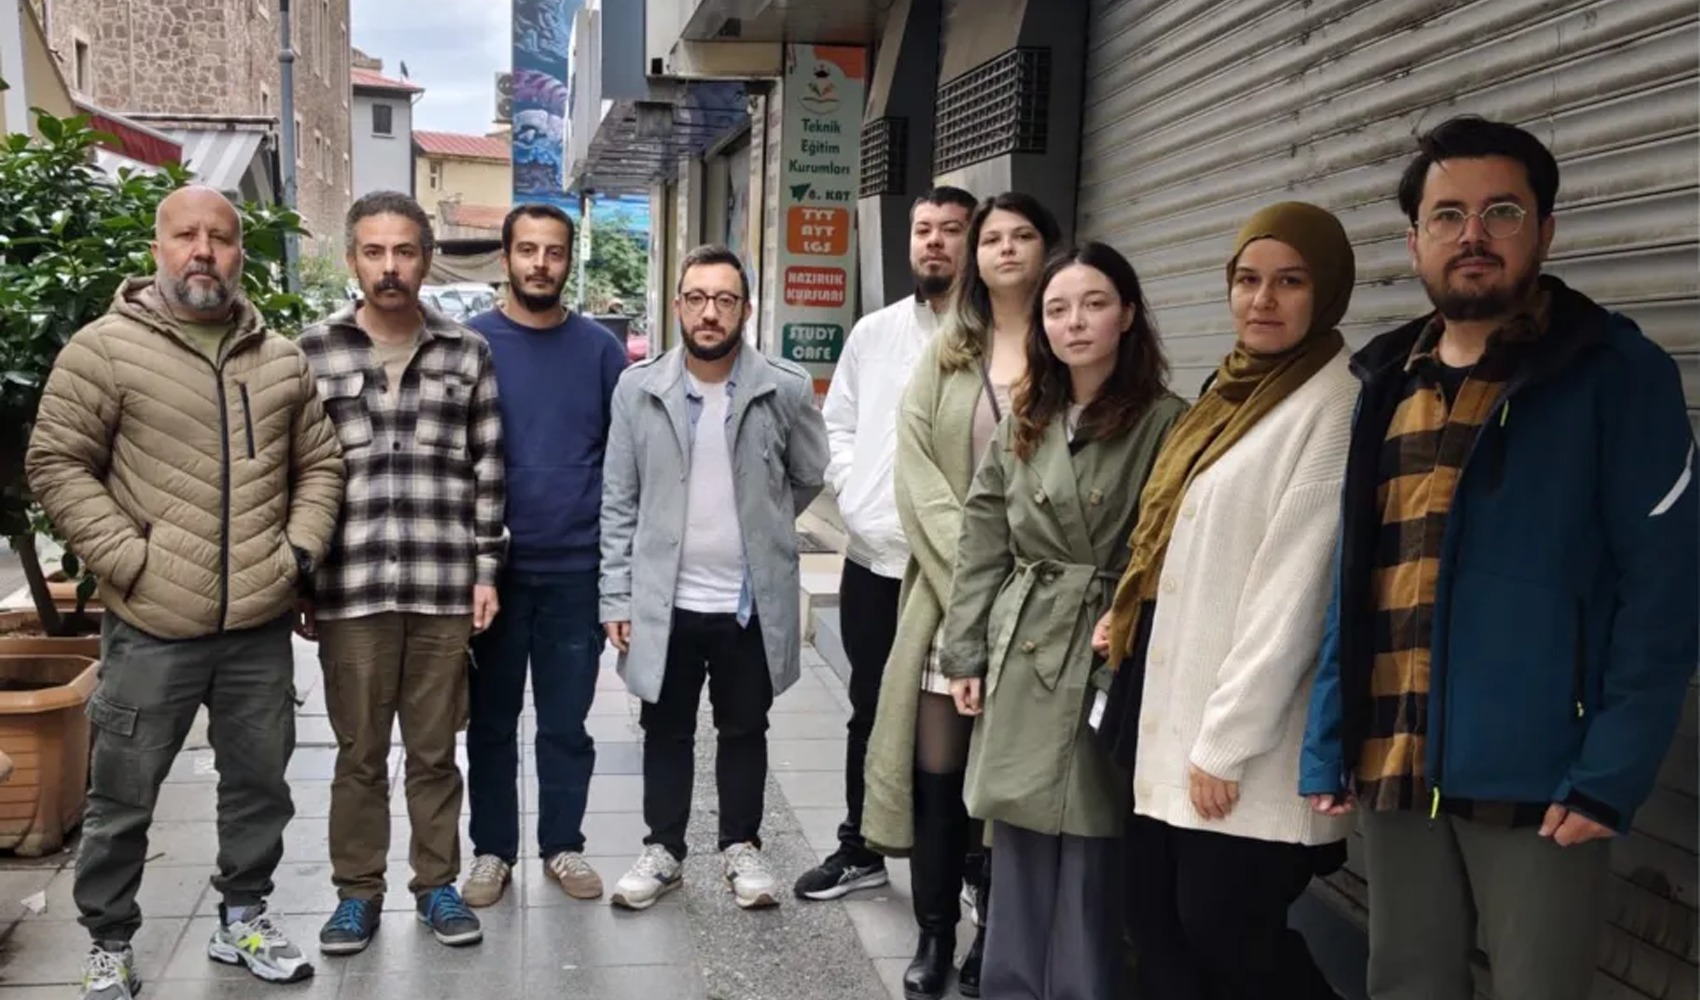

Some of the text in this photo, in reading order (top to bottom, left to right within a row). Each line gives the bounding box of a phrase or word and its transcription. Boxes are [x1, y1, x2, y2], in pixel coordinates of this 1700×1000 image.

[801, 118, 841, 133] Teknik
[801, 139, 840, 156] Eğitim
[789, 159, 850, 174] Kurumları
[826, 190, 851, 201] KAT
[802, 209, 835, 221] TYT
[801, 225, 835, 237] AYT
[803, 241, 831, 253] LGS
[786, 288, 843, 301] KURSLARI
[788, 327, 836, 341] STUDY
[792, 346, 832, 360] CAFE
